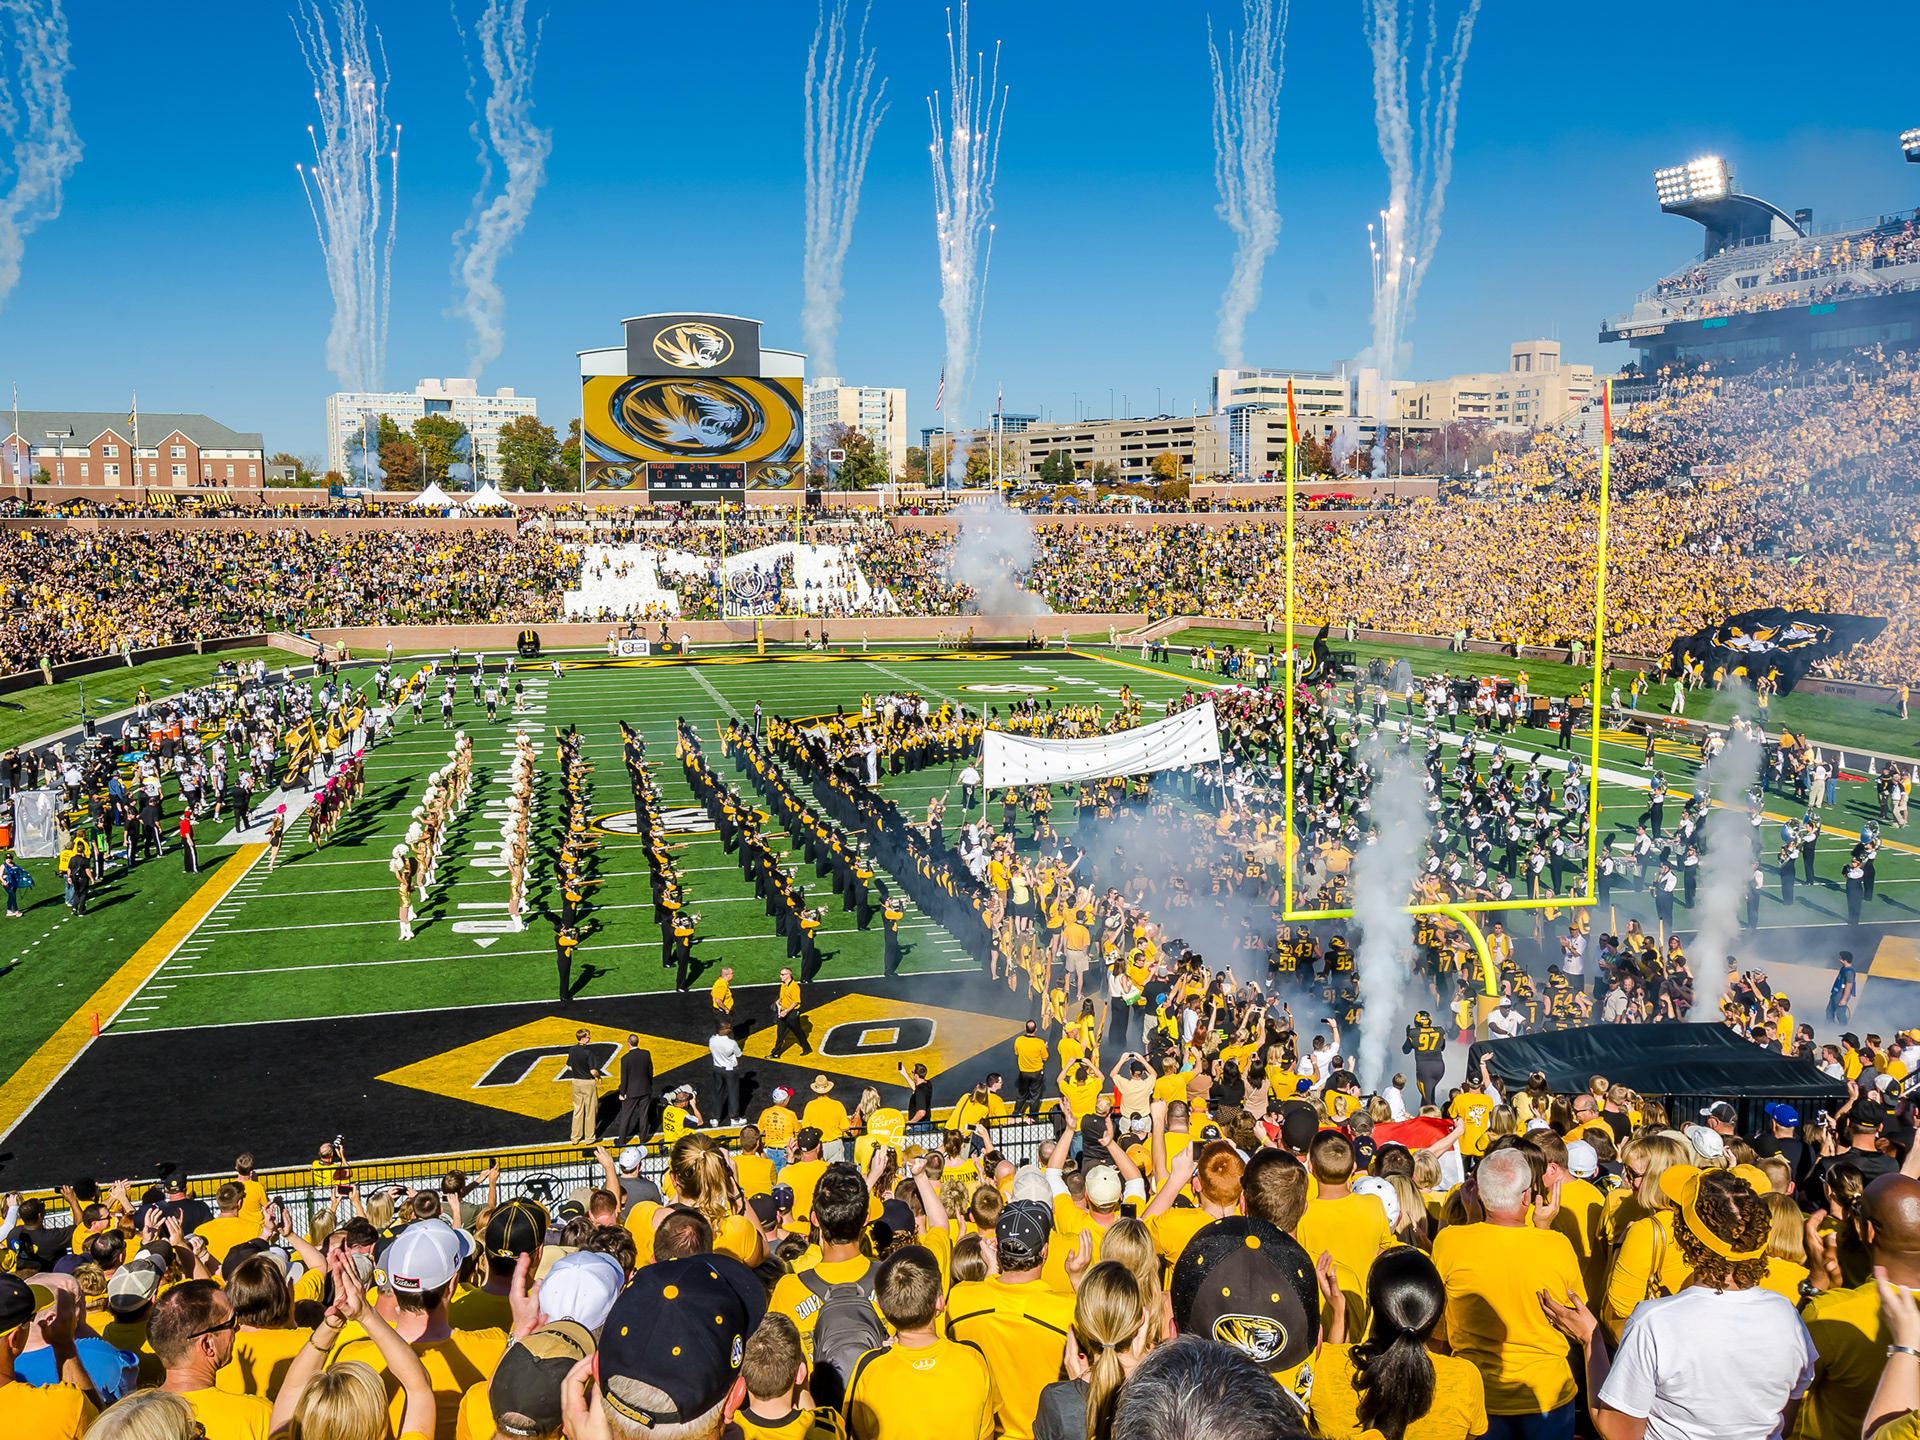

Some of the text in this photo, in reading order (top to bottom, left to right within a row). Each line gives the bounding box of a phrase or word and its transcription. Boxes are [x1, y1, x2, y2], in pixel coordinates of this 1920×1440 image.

[1809, 303, 1836, 316] Airgas
[1702, 317, 1728, 329] Airgas
[1630, 326, 1666, 338] MIZZOU
[724, 600, 776, 616] Allstate
[1005, 795, 1018, 804] 99
[1245, 866, 1260, 878] 69
[1294, 943, 1313, 957] 43
[1278, 956, 1296, 971] 50
[1336, 955, 1352, 971] 95
[1418, 1033, 1440, 1051] 97
[871, 1118, 900, 1128] TIGERS!
[606, 1392, 650, 1425] MIZZOU
